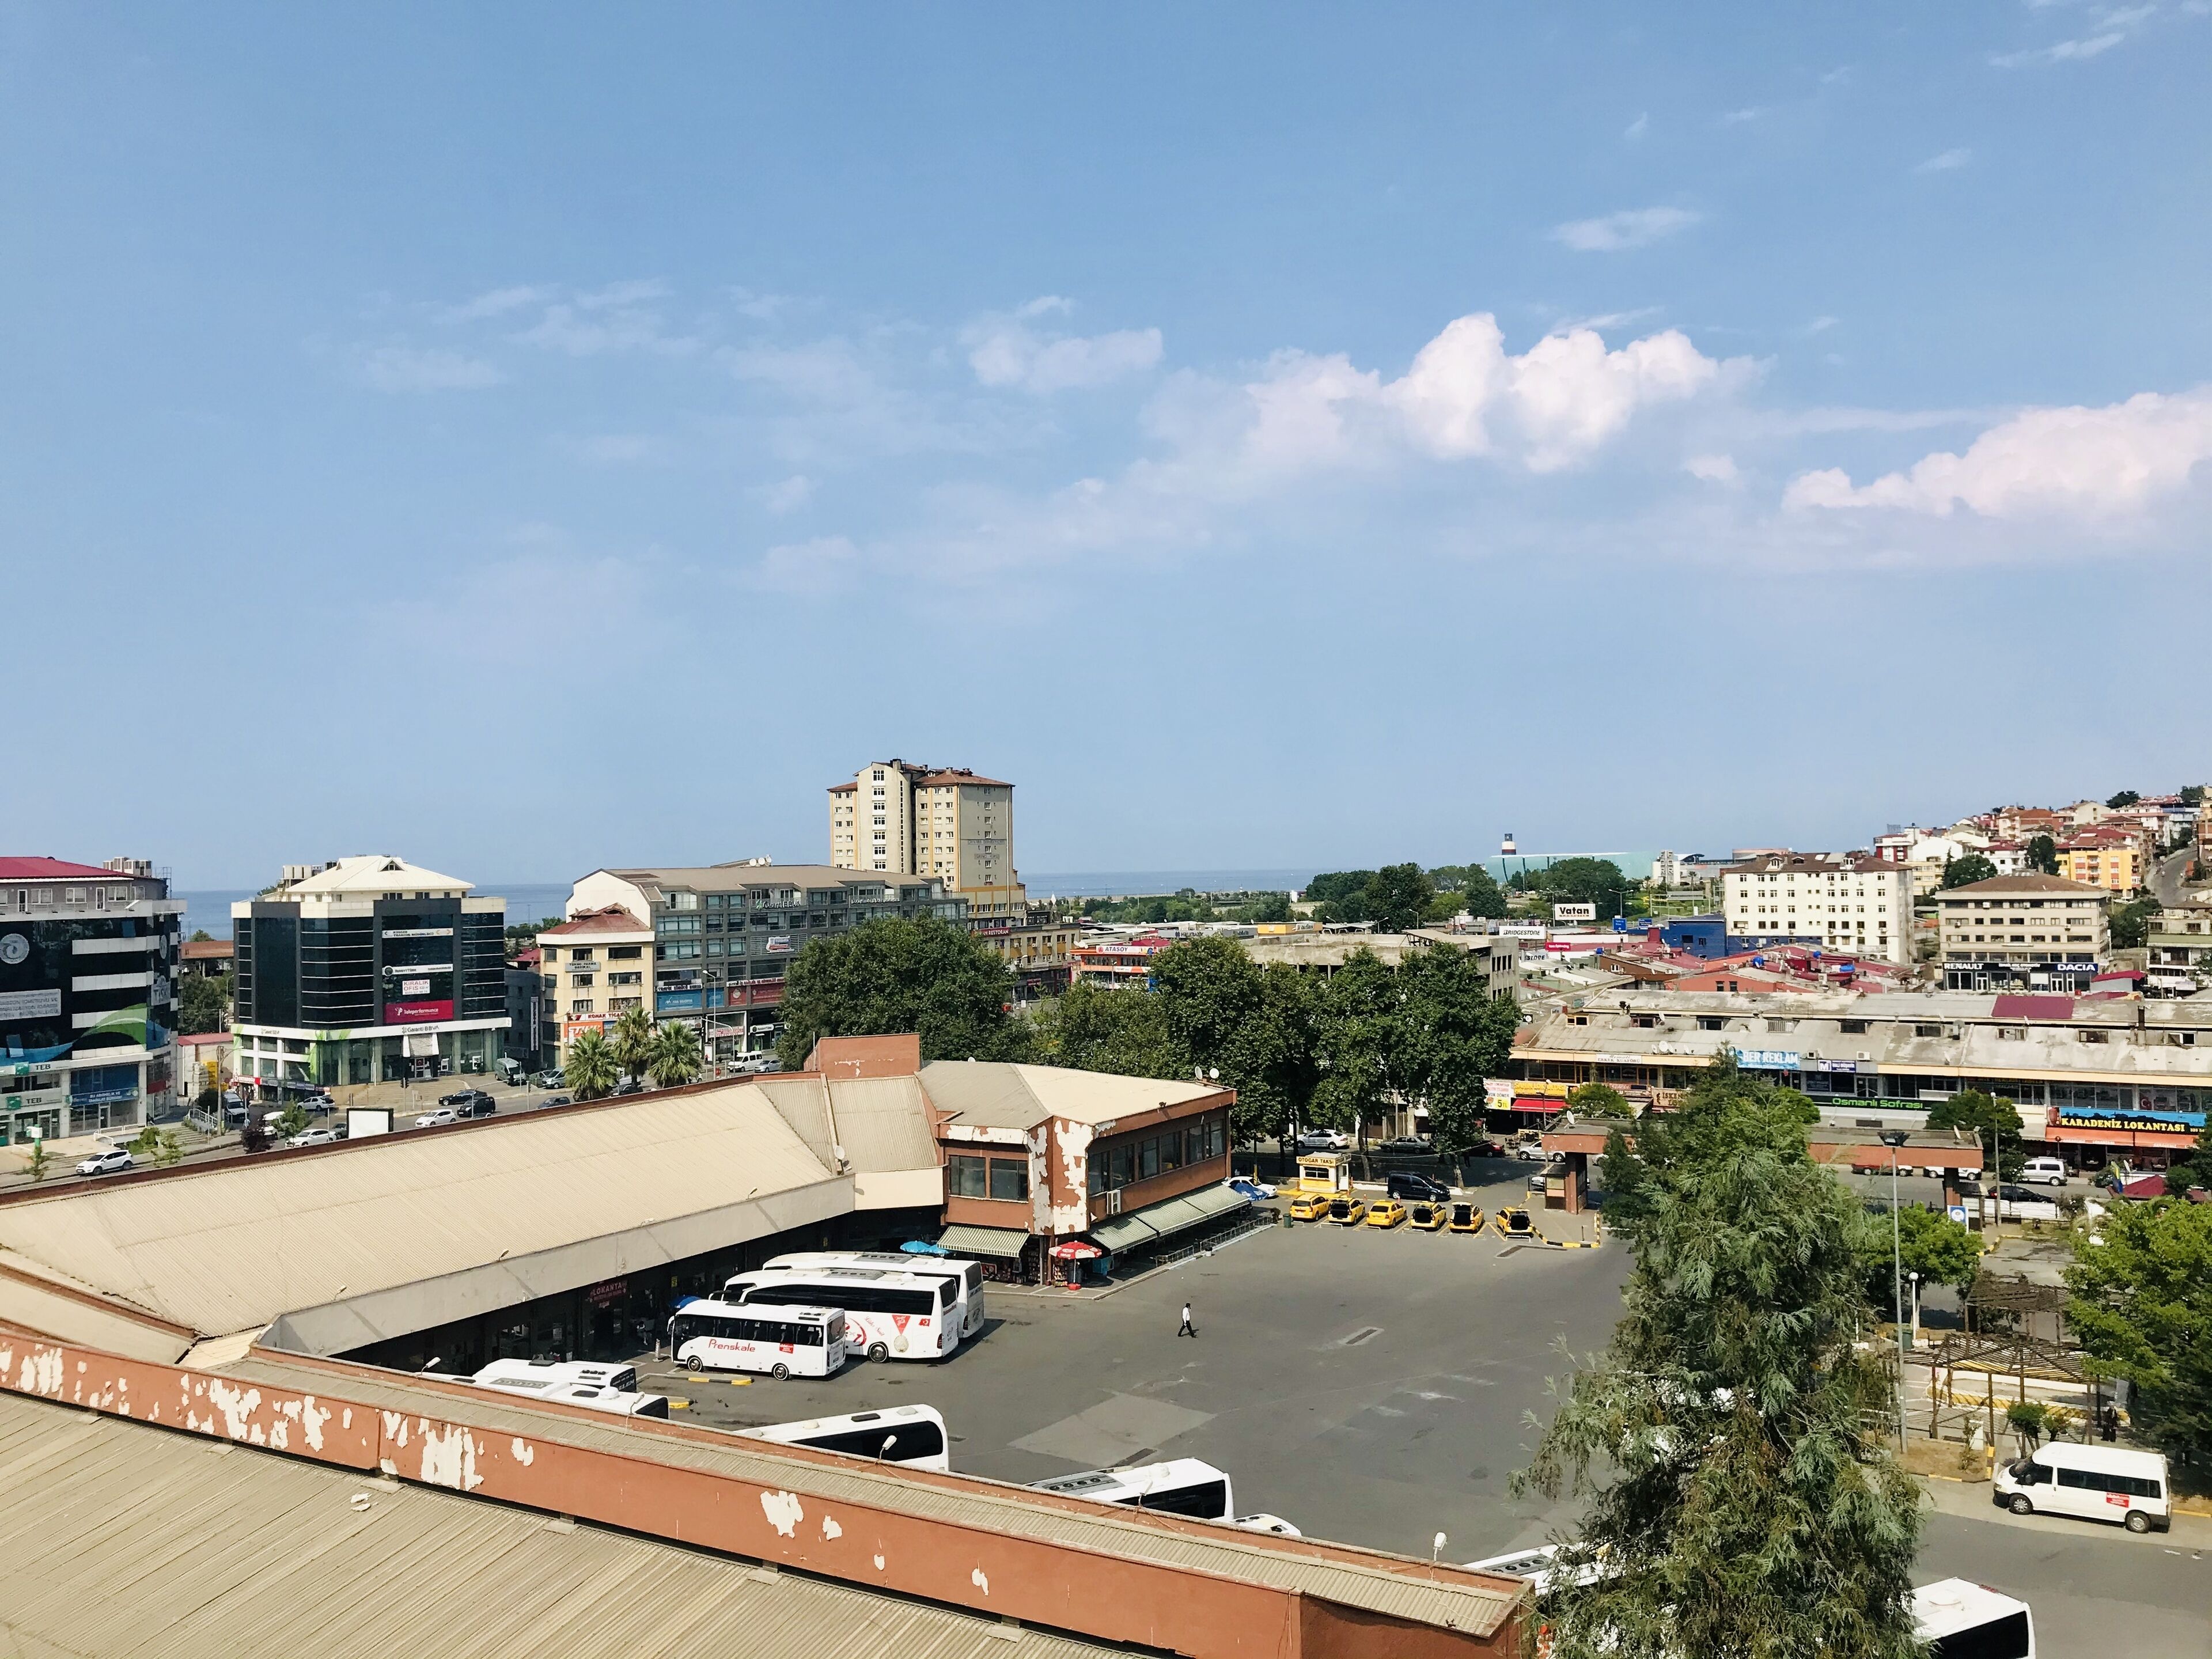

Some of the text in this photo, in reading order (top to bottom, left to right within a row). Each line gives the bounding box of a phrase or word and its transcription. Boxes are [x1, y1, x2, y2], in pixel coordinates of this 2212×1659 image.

[1763, 1052, 1798, 1065] REKLAM
[1832, 1097, 1923, 1109] Osmanlı Sofrası
[2061, 1118, 2122, 1129] KARADENİZ
[2124, 1120, 2186, 1132] LOKANTASI
[593, 1282, 622, 1296] LOKANTA
[709, 1338, 756, 1352] Prenskale
